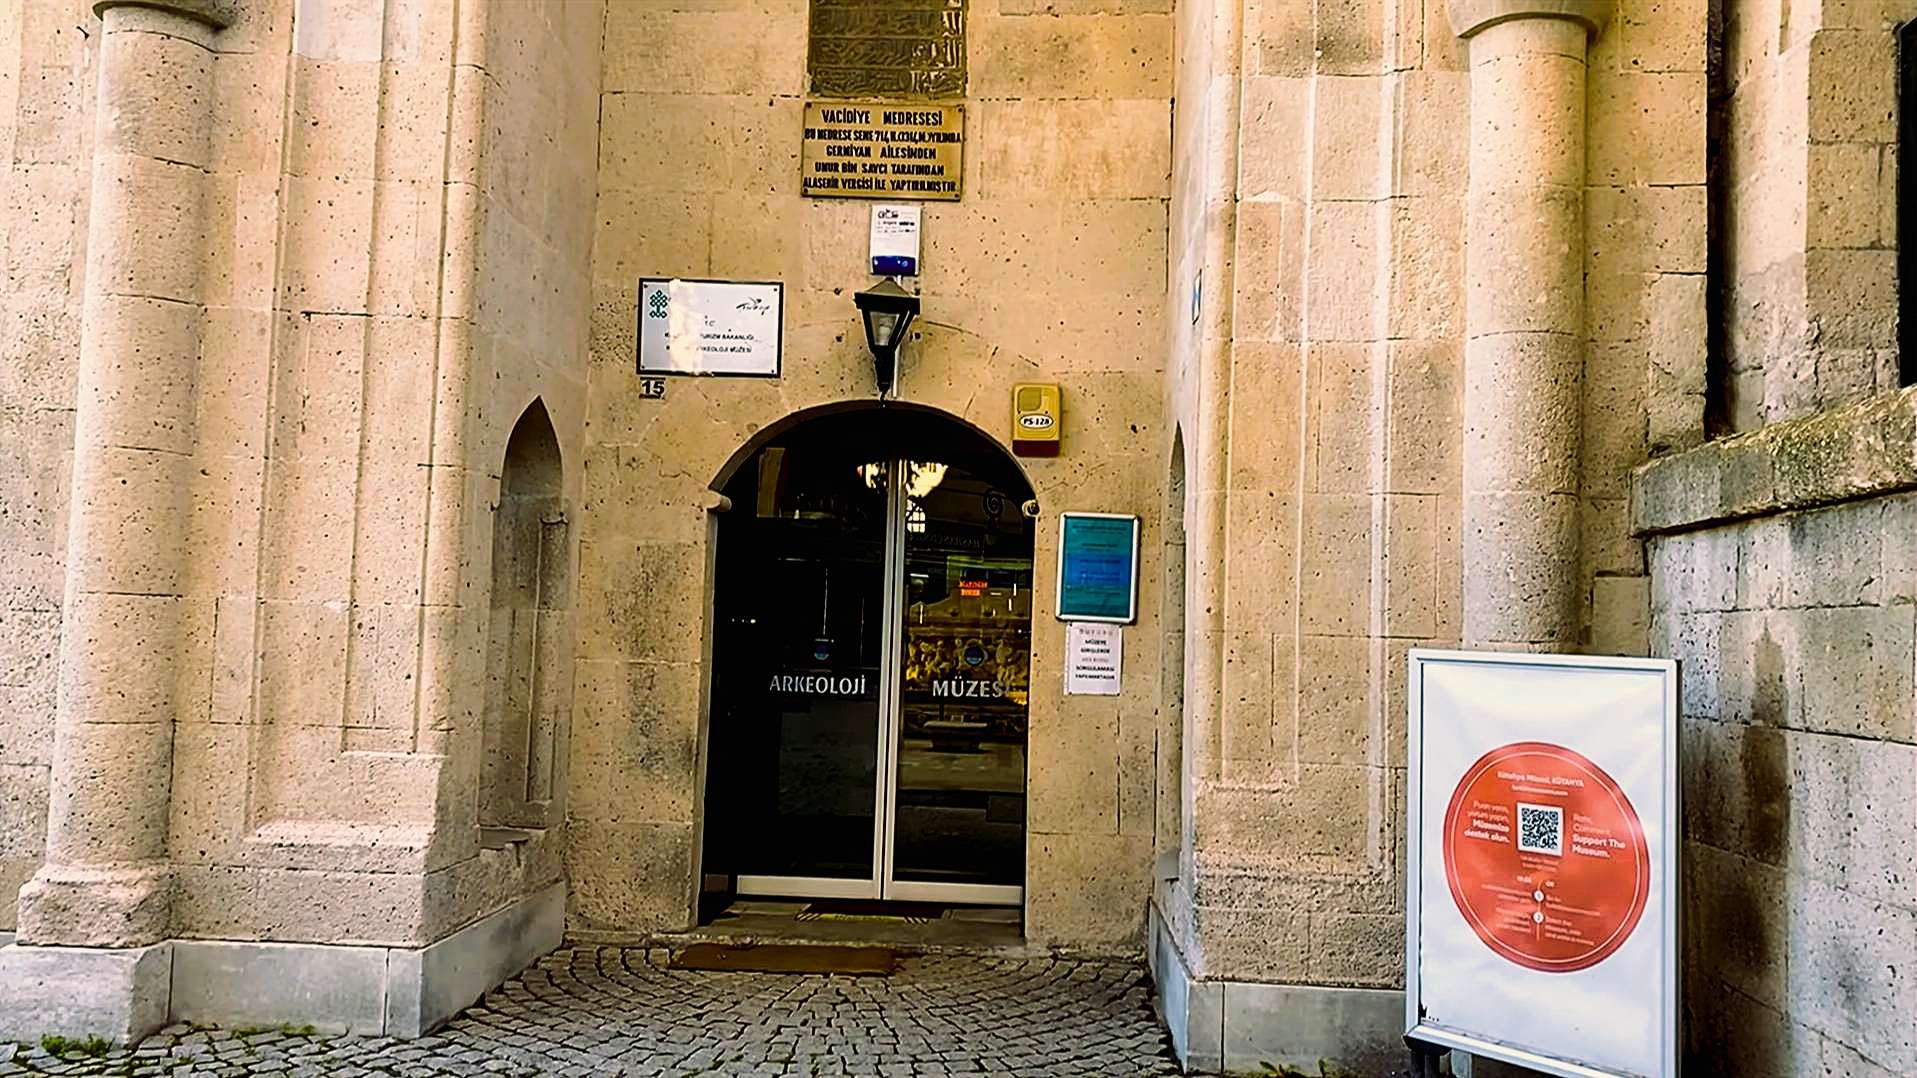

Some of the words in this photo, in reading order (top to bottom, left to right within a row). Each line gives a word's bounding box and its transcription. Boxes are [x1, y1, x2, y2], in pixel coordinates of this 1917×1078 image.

[822, 107, 871, 124] VACİDİYE
[883, 109, 943, 126] MEDRESESİ
[804, 128, 816, 140] BU
[817, 128, 852, 141] MEDRESE
[853, 130, 873, 142] SENE
[880, 144, 937, 159] AİLESİNDEN
[841, 160, 858, 173] BİN
[891, 163, 945, 177] TARAFINDAN
[641, 380, 665, 396] 15
[769, 674, 867, 695] ARKEOLOJİ
